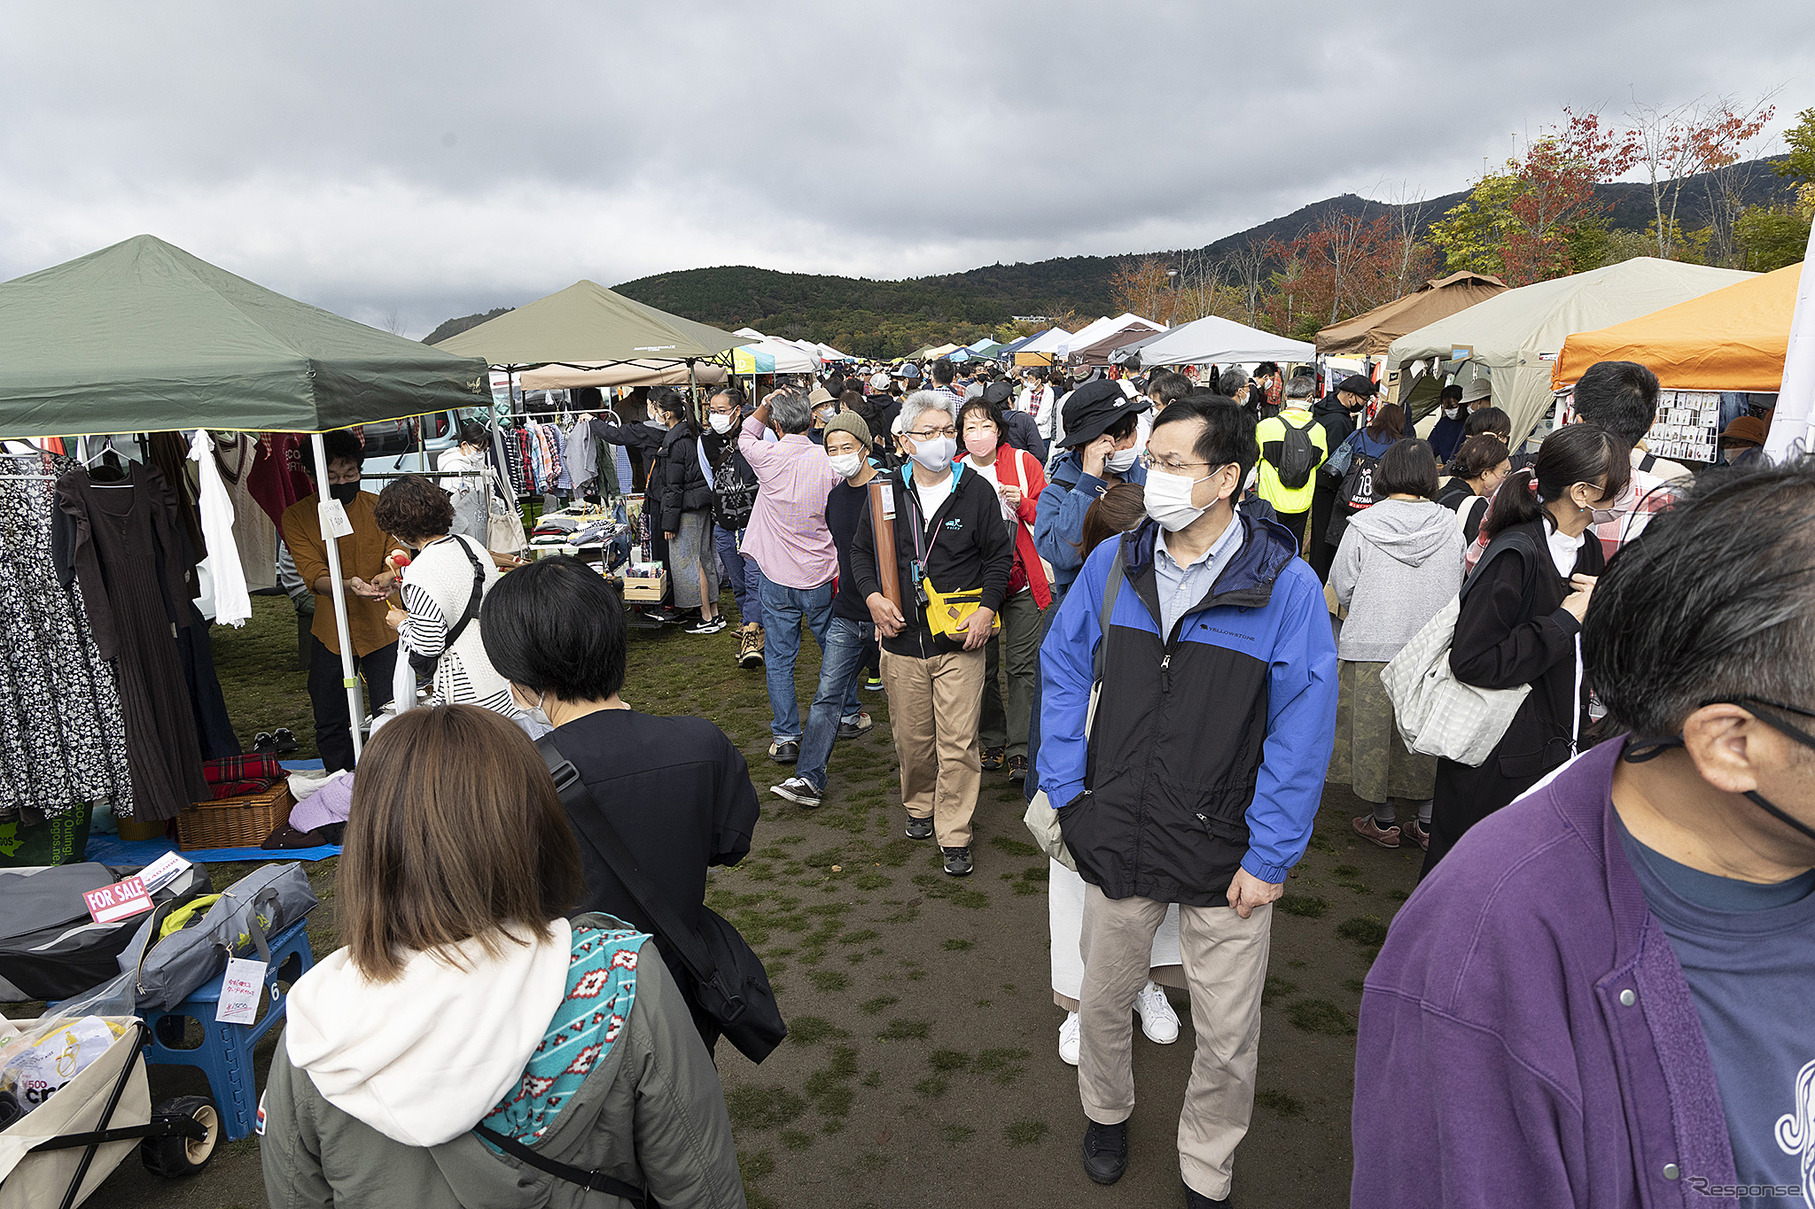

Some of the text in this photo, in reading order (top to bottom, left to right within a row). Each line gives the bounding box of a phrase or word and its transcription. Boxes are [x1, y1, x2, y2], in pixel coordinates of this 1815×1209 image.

[1358, 475, 1372, 496] 18
[1208, 626, 1255, 641] YELLOWSTONE
[62, 819, 74, 856] Outing!
[87, 879, 145, 911] FOR SALE
[270, 982, 280, 1001] 6
